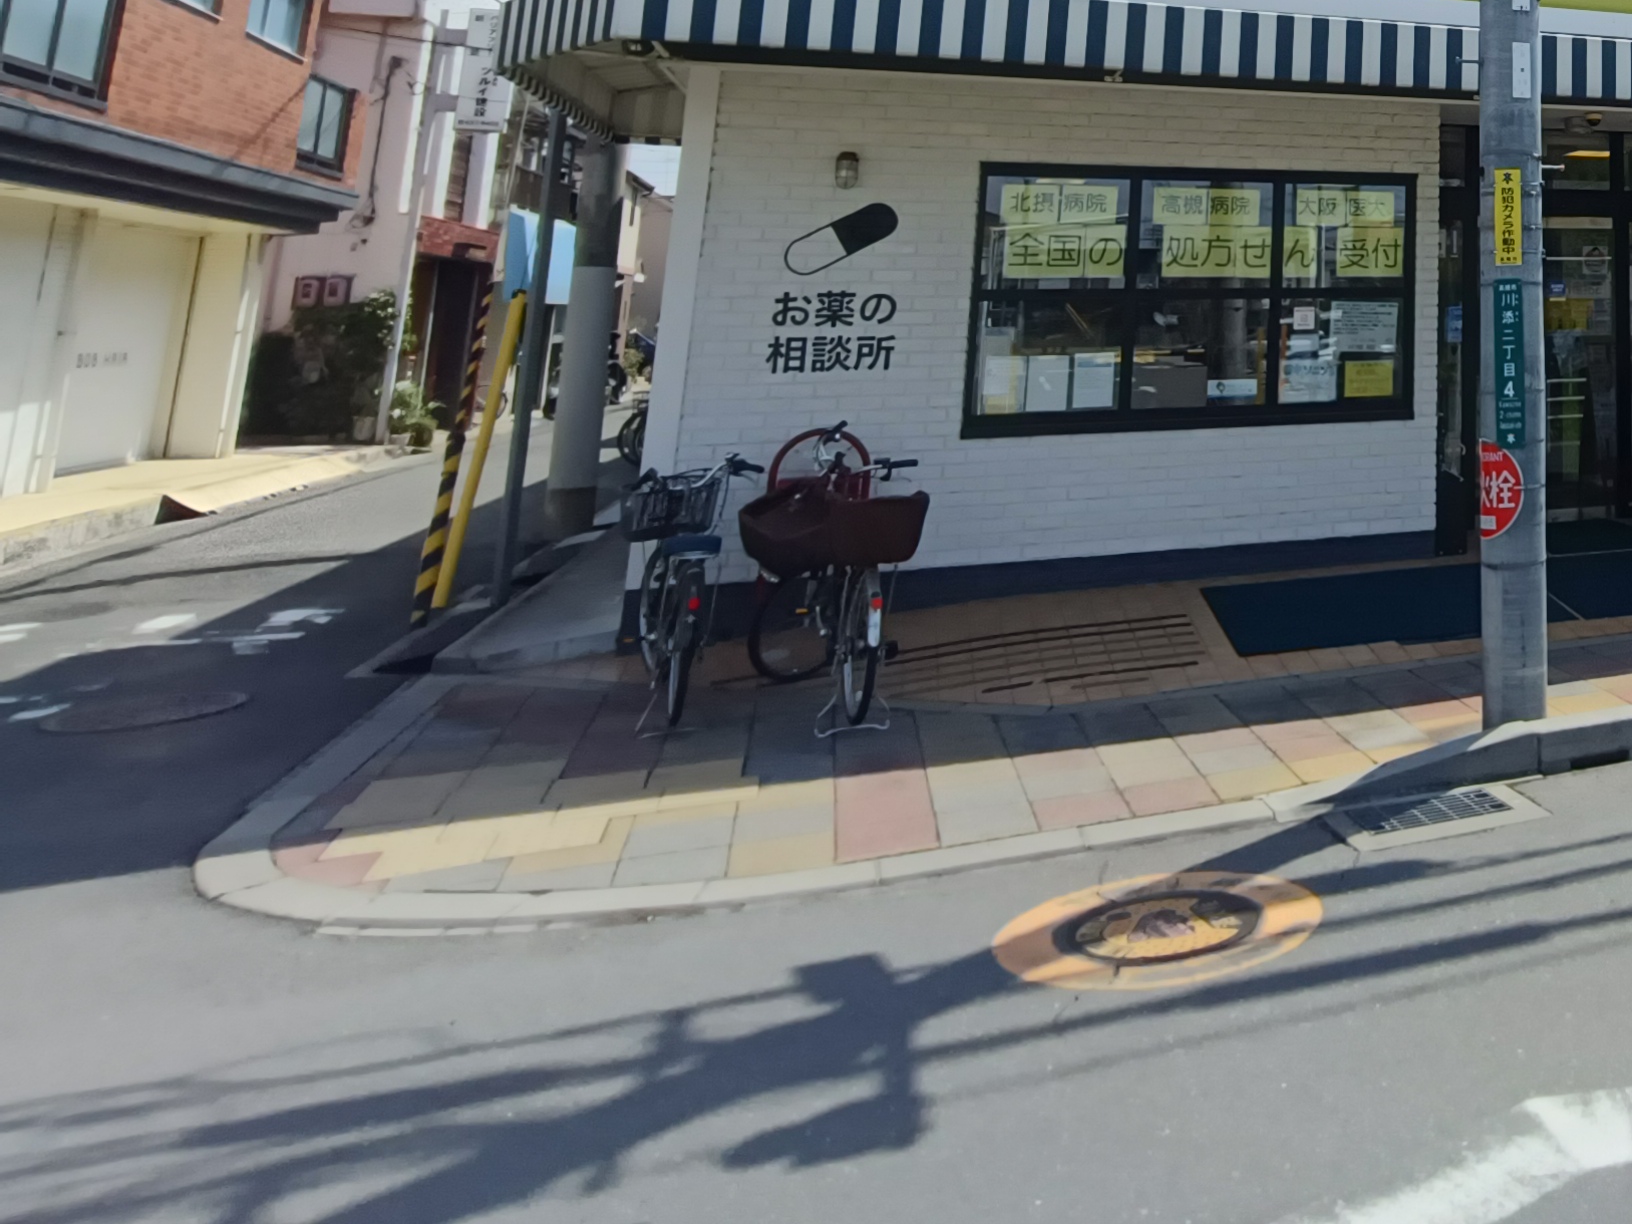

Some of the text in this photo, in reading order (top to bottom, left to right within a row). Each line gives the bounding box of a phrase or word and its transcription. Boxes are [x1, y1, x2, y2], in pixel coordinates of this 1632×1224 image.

[1010, 191, 1387, 218] 北摂病院 高槻病院 大阪医大
[1501, 187, 1516, 255] 防犯カメラ作動中
[771, 290, 897, 328] お薬の
[766, 334, 896, 374] 相談所
